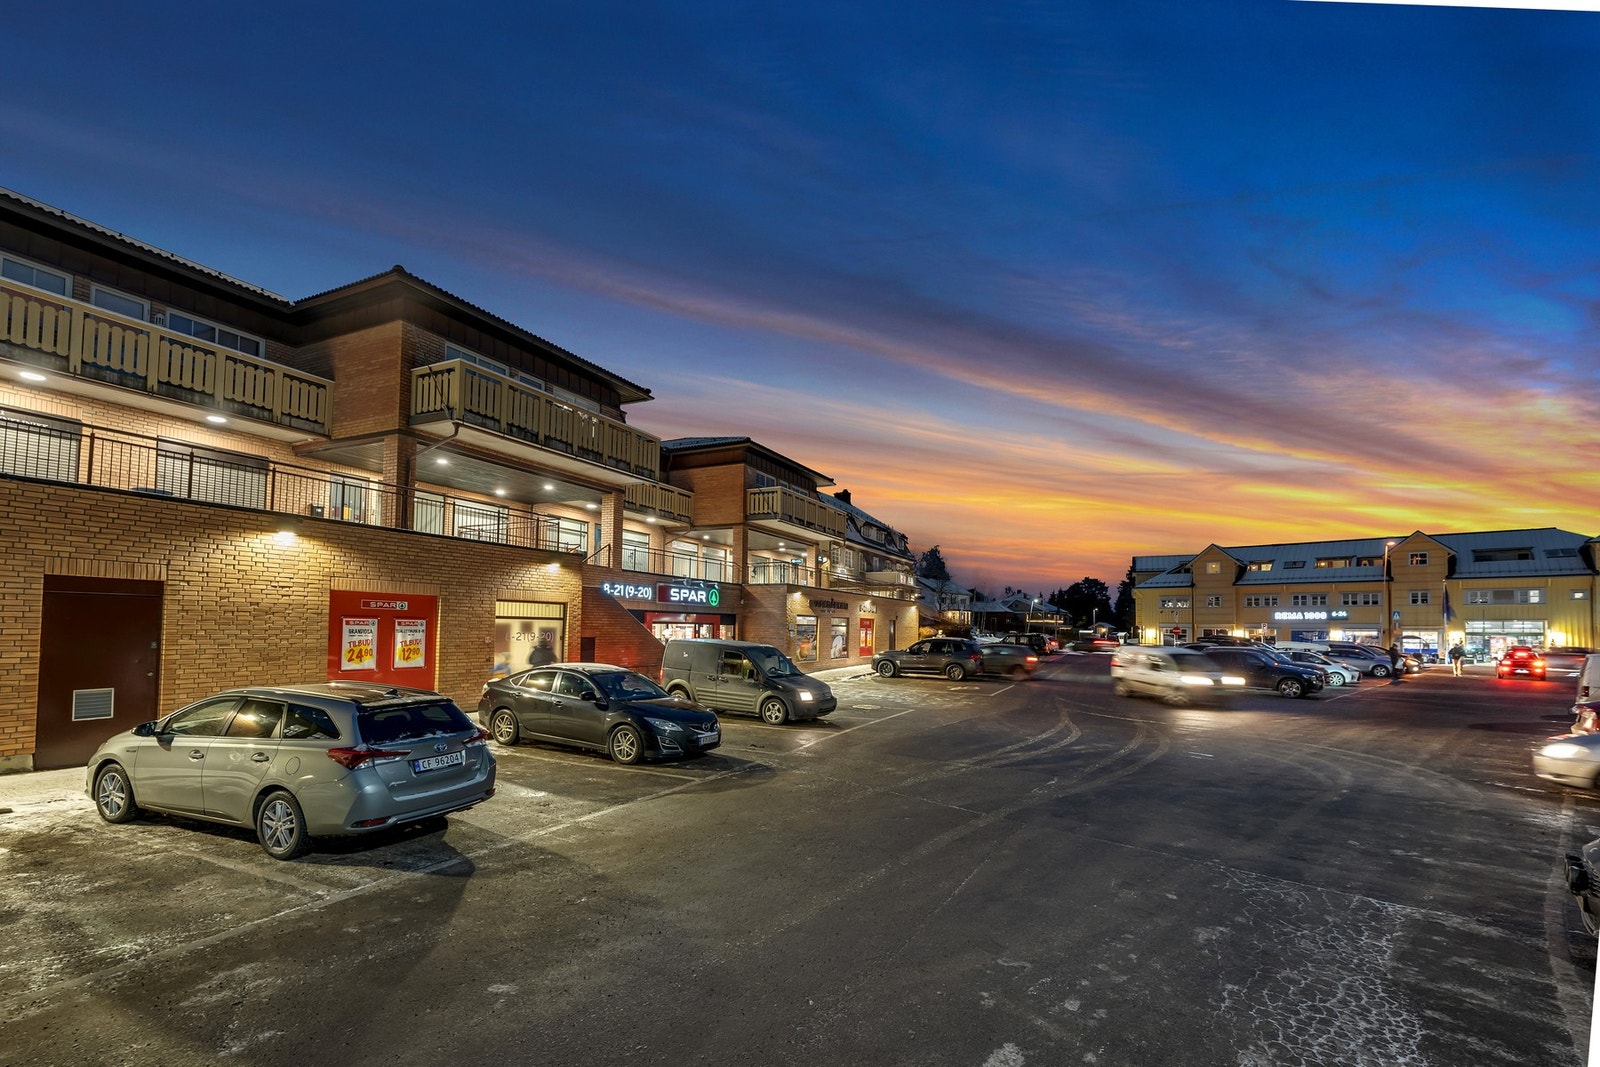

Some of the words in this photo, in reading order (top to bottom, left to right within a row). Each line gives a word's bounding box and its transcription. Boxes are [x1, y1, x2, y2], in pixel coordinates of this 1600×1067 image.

[670, 588, 707, 602] SPAR
[1274, 612, 1304, 620] REMA
[1304, 612, 1327, 620] 1000
[347, 638, 373, 648] TILBUD!
[422, 760, 431, 769] CF
[435, 754, 459, 767] 96204
